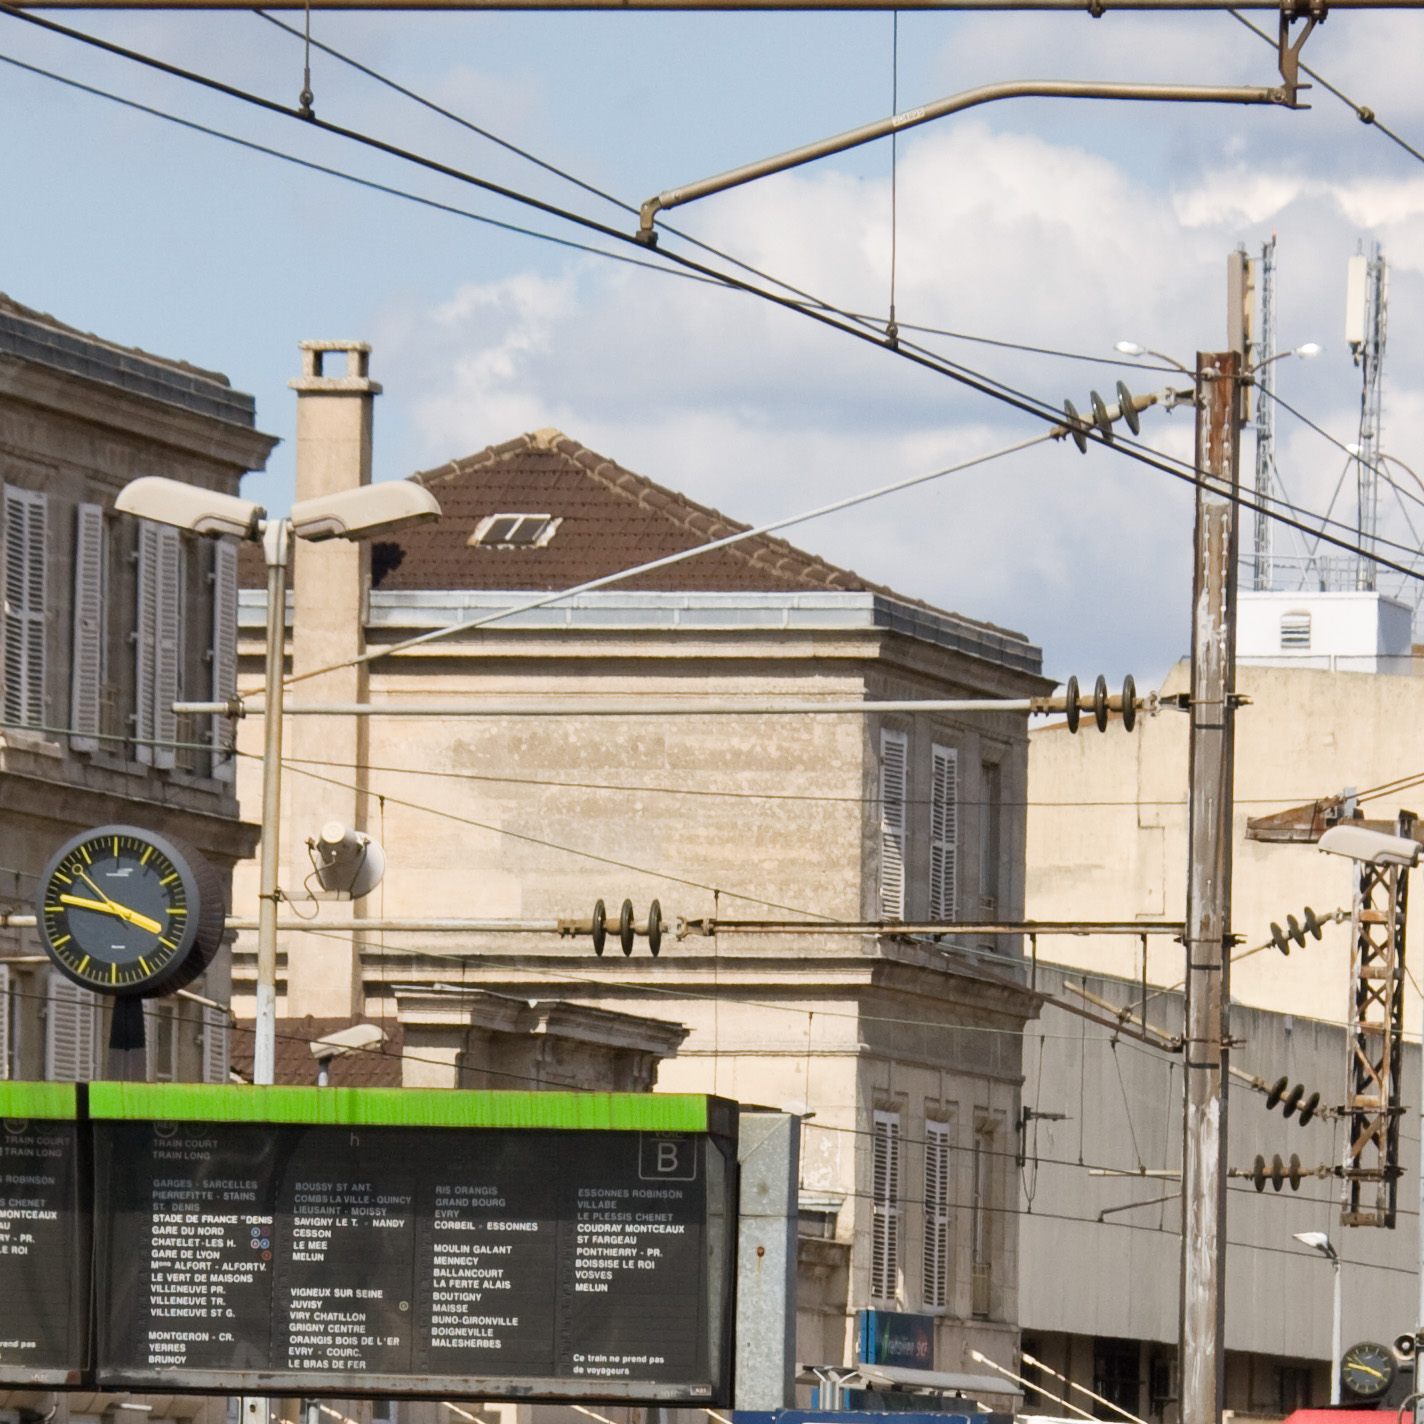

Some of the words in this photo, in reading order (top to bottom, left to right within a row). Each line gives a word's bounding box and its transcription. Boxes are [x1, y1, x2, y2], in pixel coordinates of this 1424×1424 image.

[153, 1214, 184, 1223] STADE
[185, 1214, 199, 1223] DE
[201, 1215, 238, 1224] FRANCE
[294, 1217, 333, 1226] SAVIGNY
[336, 1218, 348, 1227] LE
[372, 1219, 405, 1228] NANDY
[152, 1225, 178, 1235] GARE
[180, 1226, 195, 1235] DU
[197, 1226, 224, 1236] NORD
[434, 1220, 475, 1230] CORBEIL
[487, 1221, 538, 1231] ESSONNES
[577, 1223, 622, 1233] COUDRAY
[625, 1224, 684, 1234] MONTCEAUX
[293, 1229, 332, 1238] CESSON
[293, 1240, 305, 1250] LE
[307, 1240, 327, 1250] MEE
[577, 1235, 588, 1244] ST
[592, 1235, 637, 1245] FARGEAU
[151, 1249, 178, 1258] GARE
[180, 1250, 193, 1259] DE
[196, 1250, 220, 1259] LYON
[434, 1244, 470, 1253] MOULIN
[473, 1245, 512, 1254] GALANT
[576, 1247, 637, 1257] PONTHIERRY
[292, 1252, 324, 1261] MELUN
[433, 1256, 478, 1266] MENNECY
[174, 1261, 211, 1270] ALFORT
[575, 1259, 619, 1268] BOISSISE
[622, 1260, 634, 1269] LE
[637, 1260, 655, 1269] ROI
[151, 1273, 163, 1282] LE
[166, 1273, 190, 1282] VERT
[194, 1273, 207, 1283] DE
[209, 1274, 253, 1283] MAISONS
[433, 1268, 503, 1278] BALLANCOURT
[575, 1270, 613, 1279] VOSVES
[151, 1284, 208, 1294] VILLENEUVE
[433, 1279, 446, 1288] LA
[449, 1279, 479, 1289] FERTE
[482, 1280, 511, 1289] ALAIS
[575, 1283, 608, 1292] MELUN
[290, 1287, 331, 1297] VIGNEUX
[334, 1288, 353, 1298] SUR
[356, 1289, 383, 1299] SEINE
[432, 1292, 481, 1301] BOUTIGNY
[150, 1296, 207, 1305] VILLENEUVE
[290, 1300, 322, 1309] JUVISY
[150, 1307, 208, 1317] VILLENEUVE
[210, 1308, 222, 1317] ST
[432, 1304, 468, 1313] MAISSE
[290, 1311, 310, 1320] VIRY
[313, 1312, 366, 1322] CHATILLON
[431, 1315, 518, 1326] BUNO-GIRONVILLE
[289, 1323, 324, 1332] GRIGNY
[327, 1324, 366, 1333] CENTRE
[431, 1327, 493, 1337] BOIGNEVILLE
[148, 1331, 209, 1341] MONTGERON
[289, 1335, 333, 1344] ORANGIS
[335, 1336, 358, 1345] BOIS
[361, 1336, 374, 1346] DE
[149, 1343, 186, 1352] YERRES
[431, 1338, 501, 1348] MALESHERBES
[288, 1346, 313, 1356] EVRY
[148, 1355, 186, 1364] BRUNOY
[573, 1354, 585, 1362] Ce
[288, 1359, 300, 1368] LE
[303, 1359, 329, 1369] BRAS
[332, 1359, 345, 1369] DE
[347, 1360, 366, 1369] FER
[573, 1366, 584, 1374] de
[586, 1367, 630, 1375] voyageurs
